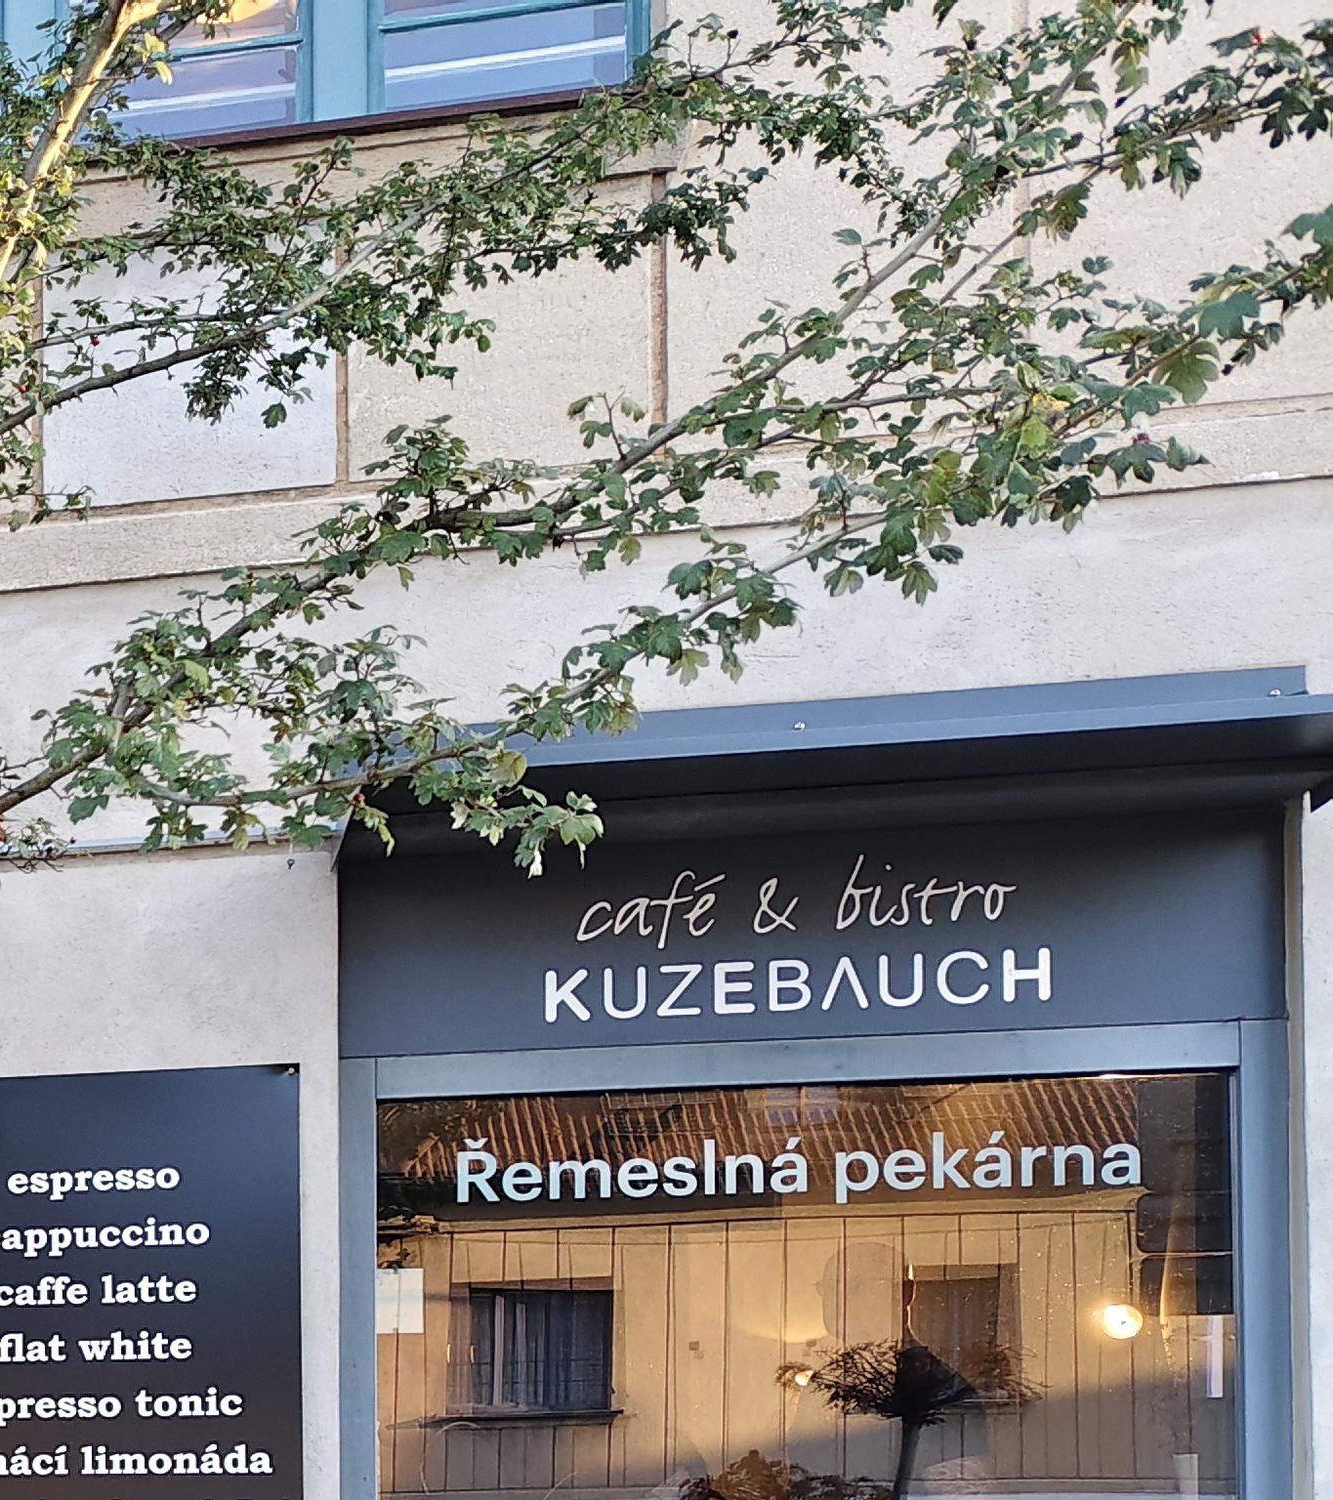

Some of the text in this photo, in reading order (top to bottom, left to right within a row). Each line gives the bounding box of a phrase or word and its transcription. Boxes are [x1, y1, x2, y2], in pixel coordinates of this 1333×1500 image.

[577, 855, 1016, 949] café & bistro
[543, 945, 1052, 1023] KUZEBAUCH
[457, 1131, 1142, 1204] Řemeslná pekárna
[7, 1167, 180, 1201] espresso
[101, 1274, 197, 1304] latte
[78, 1331, 192, 1361] white
[135, 1387, 243, 1417] tonic
[81, 1444, 273, 1475] limonáda
